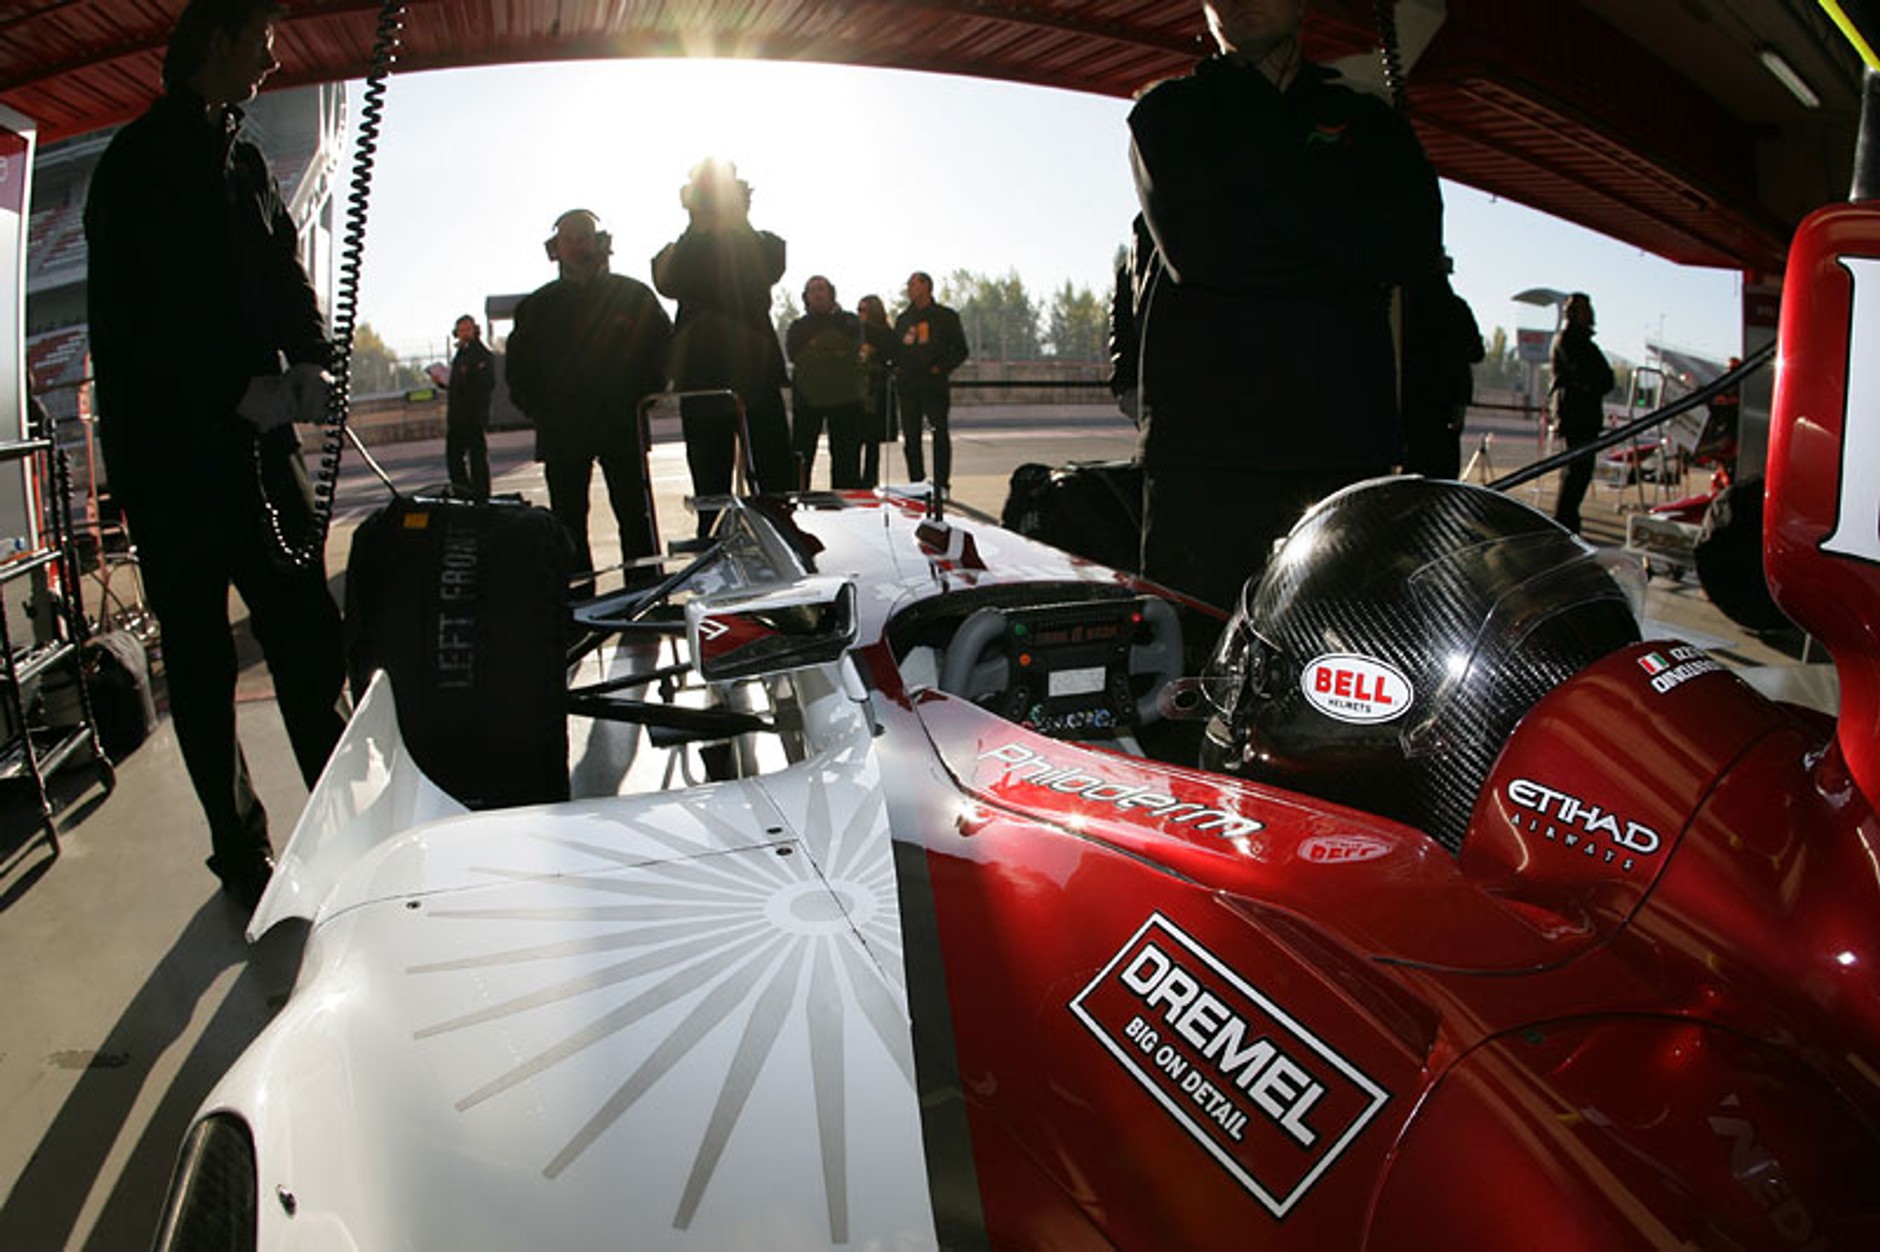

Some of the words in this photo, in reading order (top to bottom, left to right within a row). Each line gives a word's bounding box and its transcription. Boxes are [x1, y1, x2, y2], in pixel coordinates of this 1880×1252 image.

[440, 523, 477, 600] FRONT
[437, 613, 475, 689] LEFT
[1315, 666, 1393, 706] BELL
[1328, 699, 1372, 714] HELMETS
[1508, 778, 1660, 853] ETIHAD
[1510, 812, 1635, 870] AIRWAYS
[1119, 943, 1326, 1148] DREMEL
[1124, 1016, 1159, 1053] BIG
[1154, 1045, 1189, 1079] ON
[1181, 1071, 1249, 1141] DETAIL
